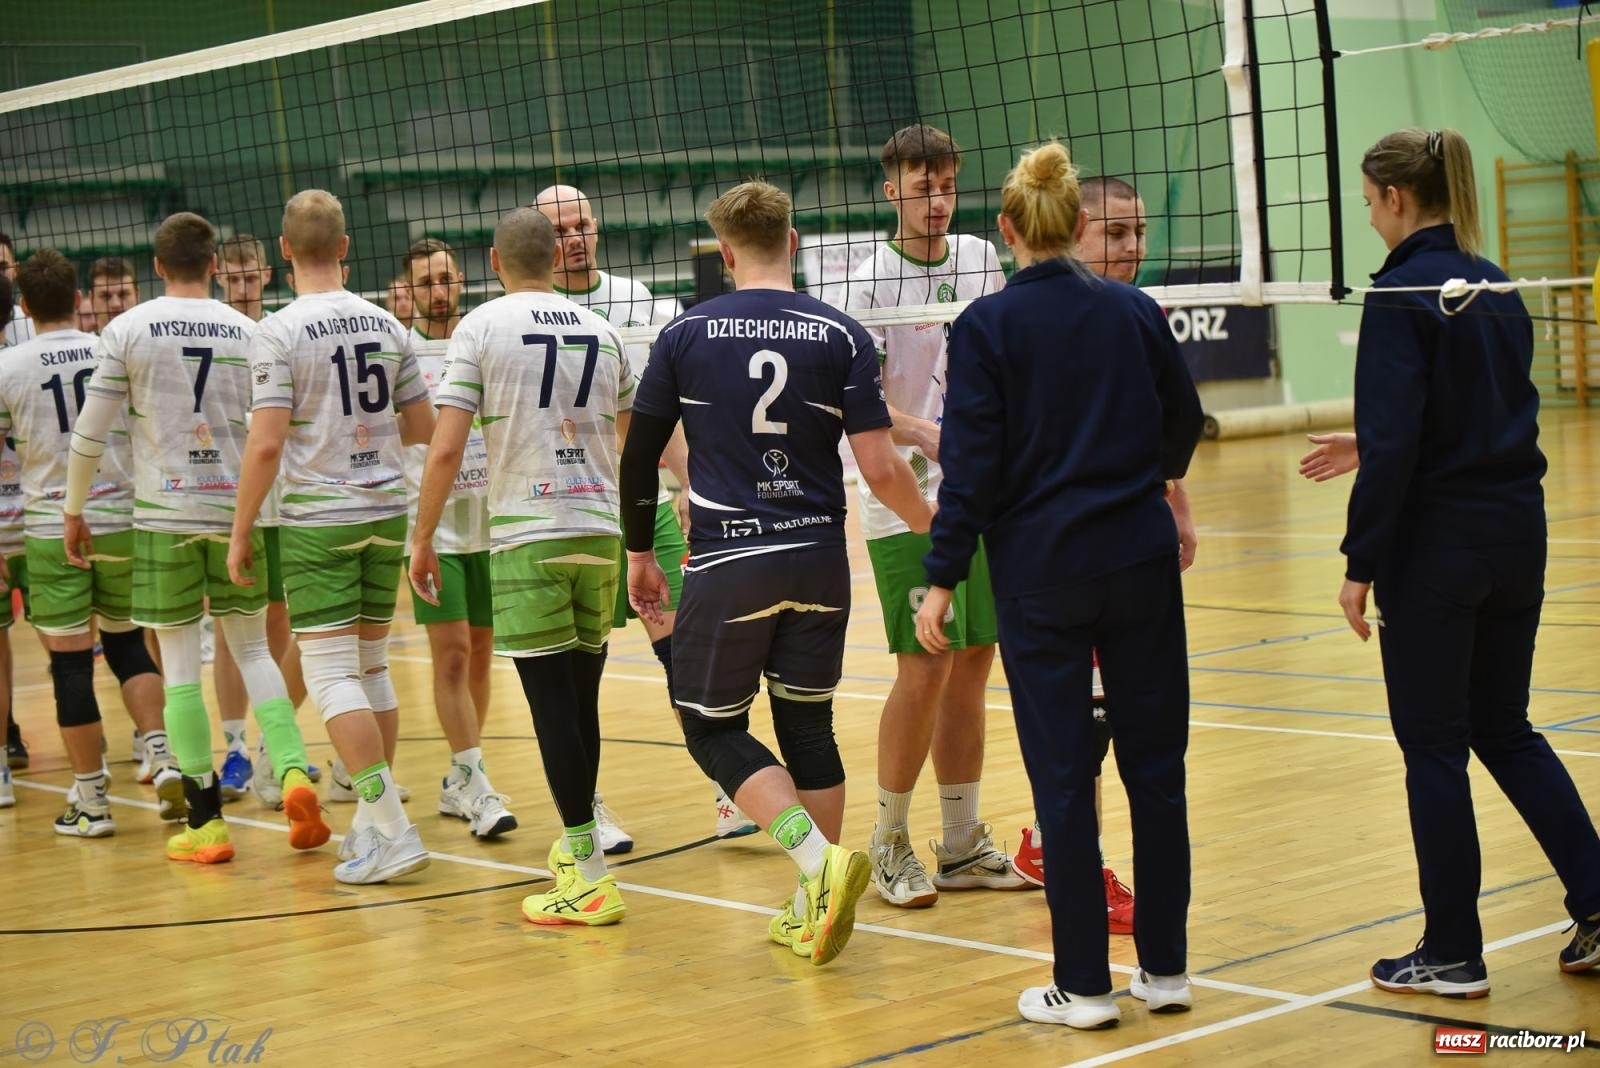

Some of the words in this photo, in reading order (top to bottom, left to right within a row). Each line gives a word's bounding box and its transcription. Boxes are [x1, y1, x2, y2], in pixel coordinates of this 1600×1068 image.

[531, 310, 581, 325] KANIA
[149, 320, 242, 340] MYSZKOWSKI
[707, 318, 829, 343] DZIECHCIAREK
[40, 346, 94, 367] SŁOWIK
[182, 346, 213, 413] 7
[330, 342, 389, 416] 15
[521, 333, 599, 408] 77
[748, 349, 788, 434] 2
[757, 481, 771, 492] MK
[773, 480, 799, 491] SPORT
[757, 489, 804, 499] FOUNDATION
[773, 515, 832, 531] KULTURALNE
